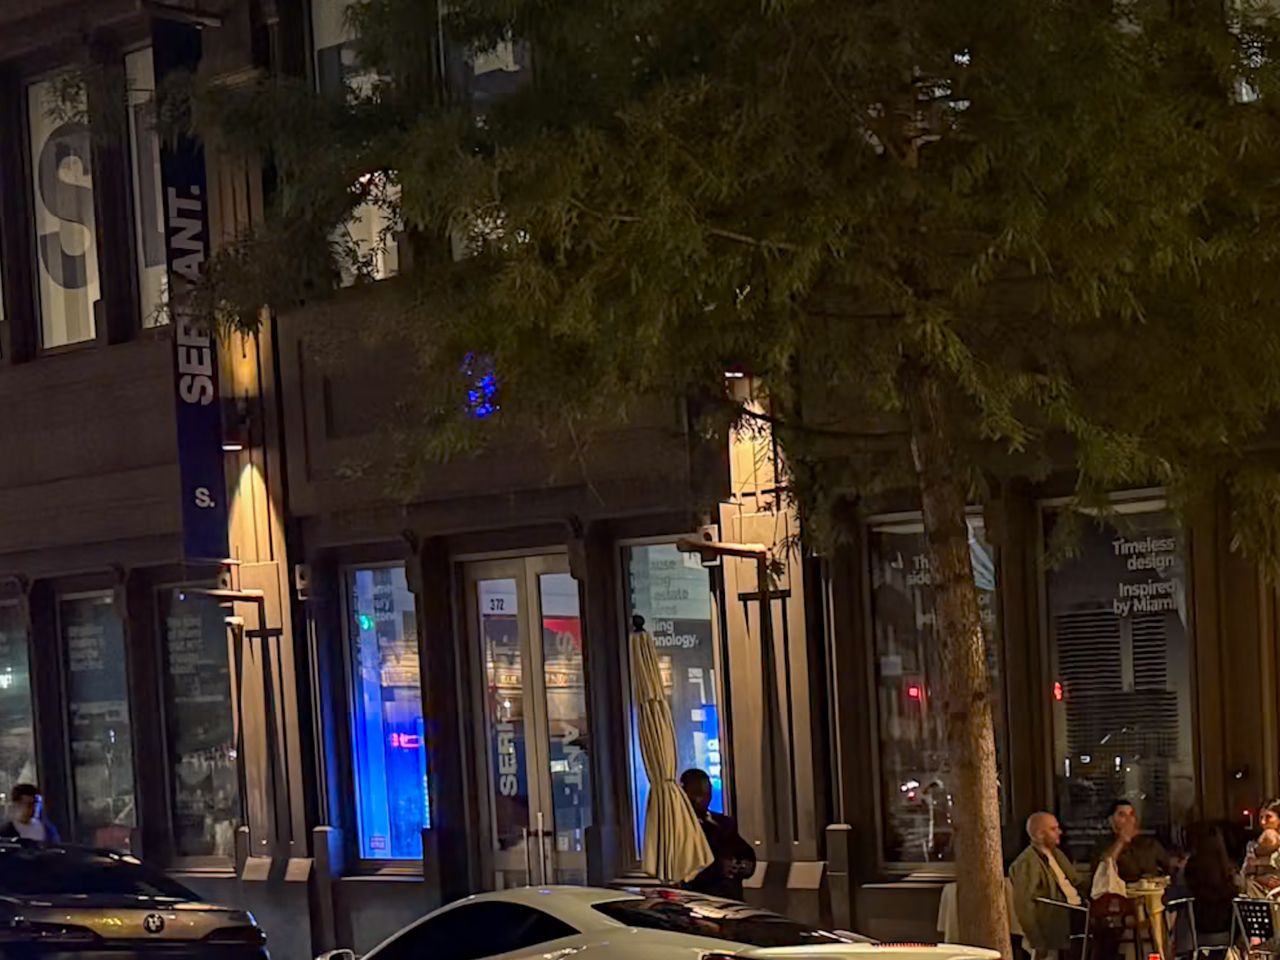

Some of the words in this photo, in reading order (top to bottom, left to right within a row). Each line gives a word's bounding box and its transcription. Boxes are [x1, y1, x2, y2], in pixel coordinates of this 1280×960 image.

[195, 486, 215, 508] S.
[1112, 536, 1176, 556] Timeless
[1127, 552, 1175, 571] design
[1118, 577, 1178, 599] Inspired
[489, 598, 505, 611] 372
[1113, 598, 1131, 617] by
[1132, 595, 1178, 613] Miami
